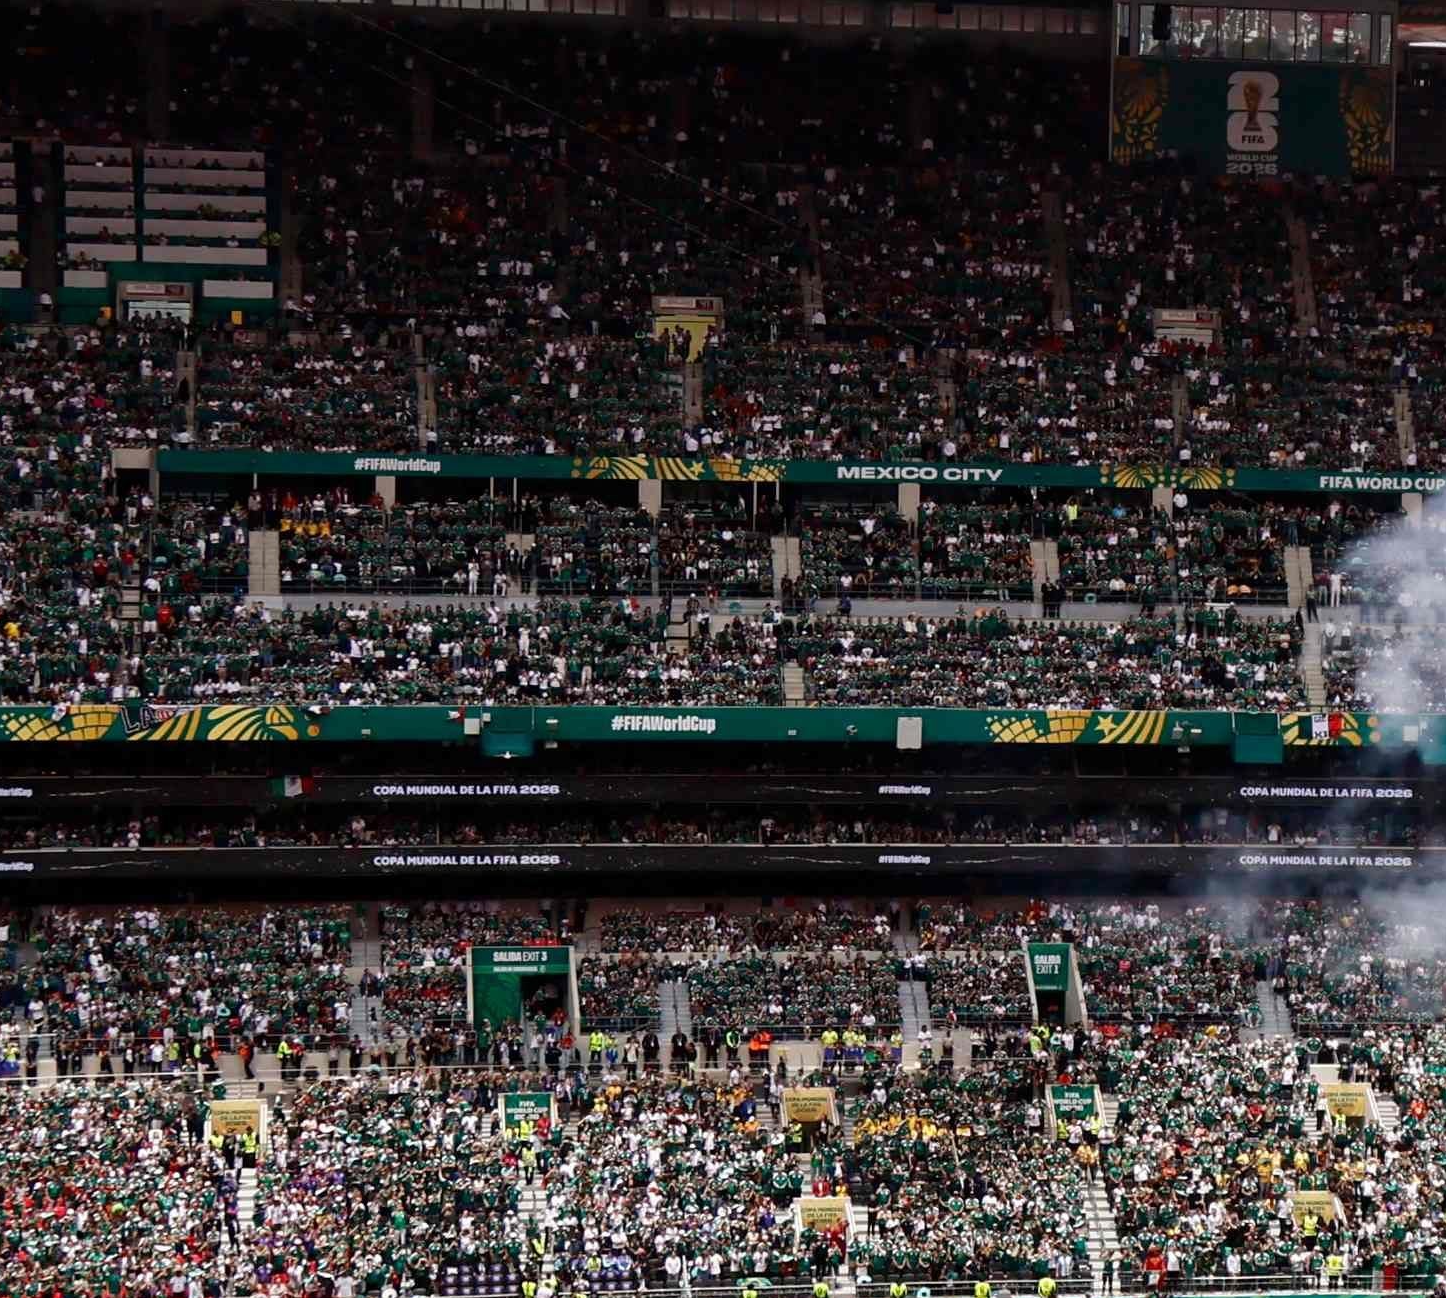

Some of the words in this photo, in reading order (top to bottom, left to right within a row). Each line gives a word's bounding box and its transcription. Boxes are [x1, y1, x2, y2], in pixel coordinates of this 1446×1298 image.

[1242, 135, 1265, 144] FIFA
[354, 457, 441, 474] #FIFAWorldCup
[837, 467, 939, 481] MEXICO
[943, 467, 1004, 482] CITY
[1320, 476, 1354, 489] FIFA
[1356, 477, 1413, 490] WORLD
[1415, 478, 1446, 491] CUP
[611, 716, 707, 735] #FIFAWorldCup
[374, 786, 405, 795] COPA
[407, 786, 458, 795] MUNDIAL
[460, 786, 475, 794] DE
[477, 786, 492, 794] LA
[494, 786, 518, 794] FIFA
[520, 785, 560, 794] 2026
[1240, 787, 1268, 796] COPA
[1270, 788, 1319, 797] MUNDIAL
[1321, 789, 1334, 797] DE
[1336, 789, 1350, 797] LA
[1352, 789, 1374, 798] FIFA
[1376, 789, 1413, 798] 2026
[374, 856, 405, 866] COPA
[407, 856, 458, 865] MUNDIAL
[460, 856, 475, 865] DE
[477, 856, 492, 865] LA
[494, 856, 518, 865] FIFA
[520, 856, 560, 865] 2026
[1240, 856, 1268, 865] COPA
[1270, 856, 1319, 866] MUNDIAL
[1321, 857, 1334, 866] DE
[1336, 857, 1350, 866] LA
[1352, 857, 1374, 866] FIFA
[1376, 857, 1413, 867] 2026
